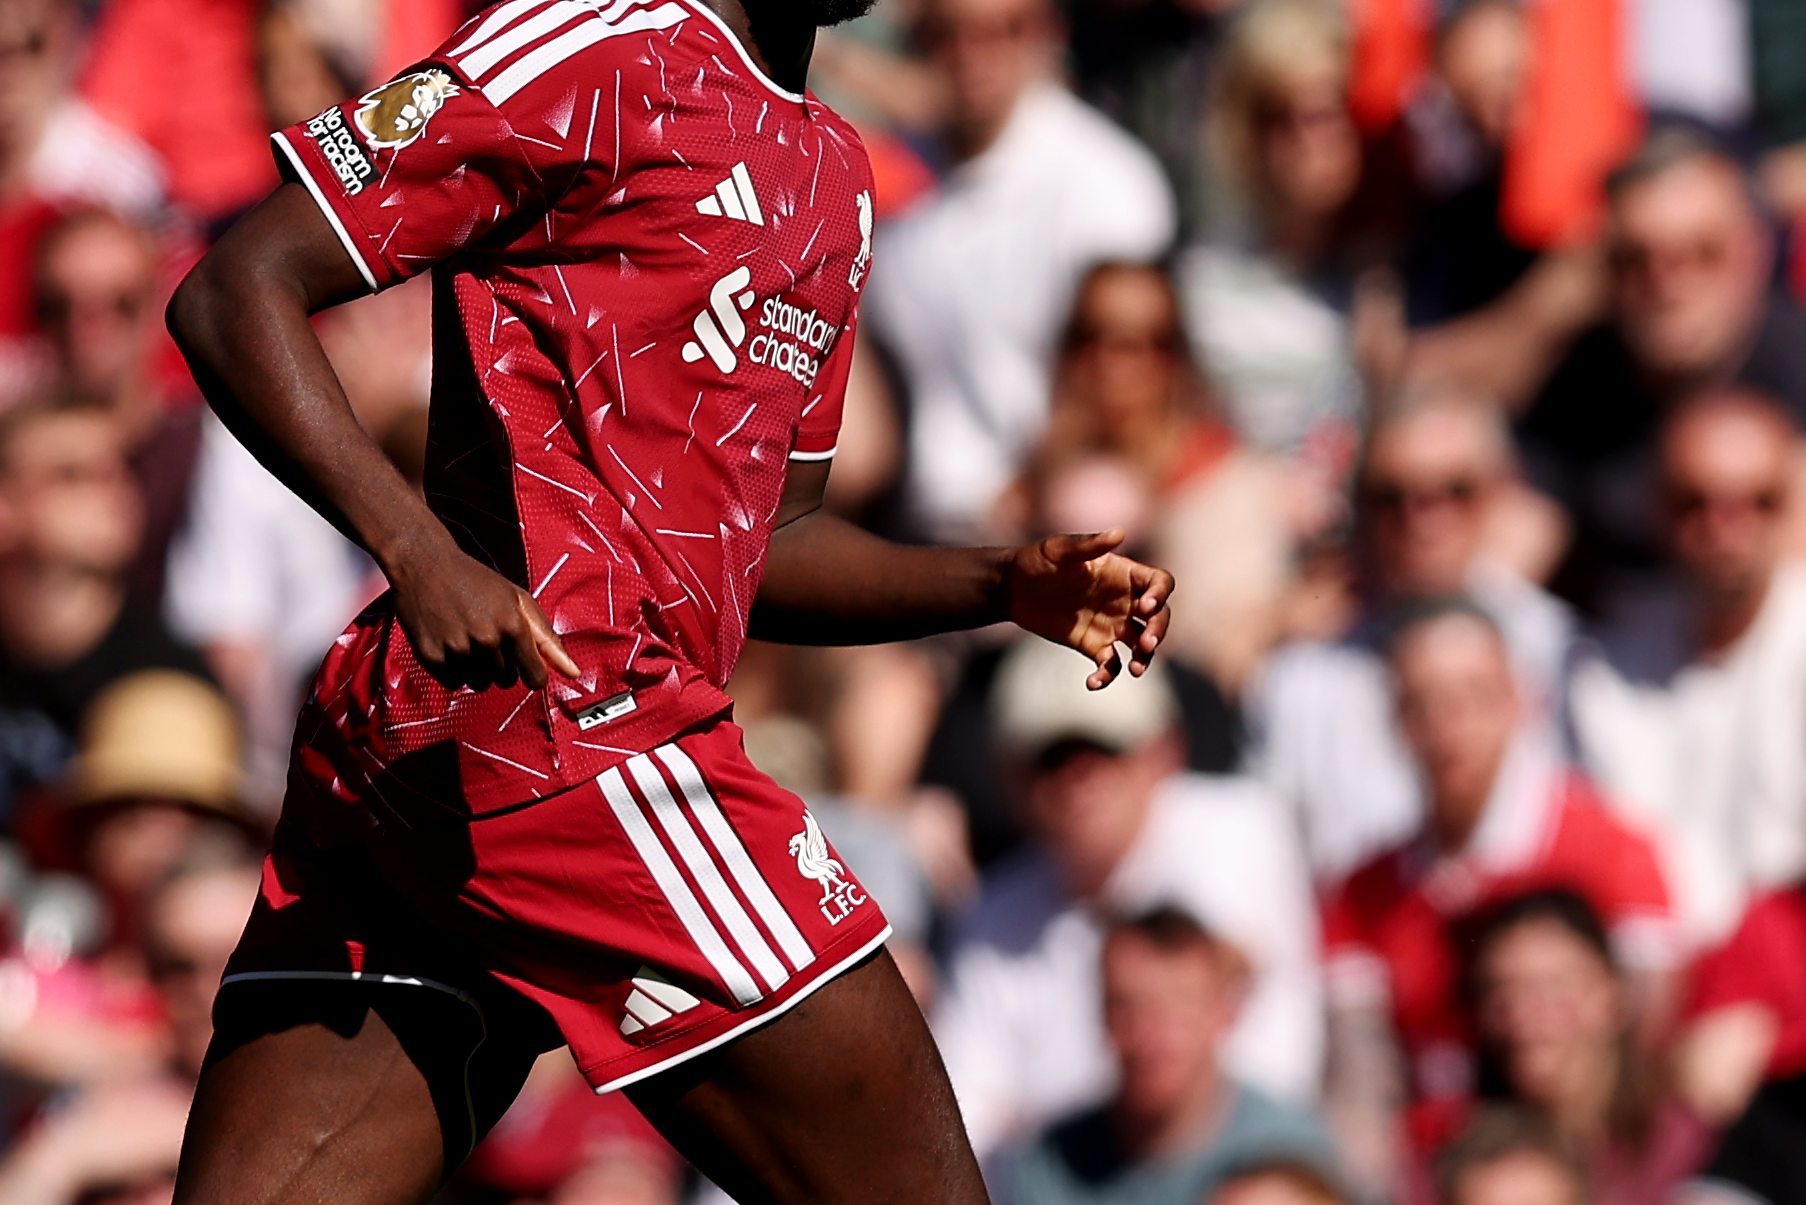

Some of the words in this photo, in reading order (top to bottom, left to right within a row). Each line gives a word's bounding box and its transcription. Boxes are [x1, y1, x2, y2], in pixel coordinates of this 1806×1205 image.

[306, 115, 329, 138] for
[318, 135, 363, 196] racism
[321, 105, 342, 130] No
[333, 126, 371, 179] room
[820, 883, 867, 926] L.F.C.
